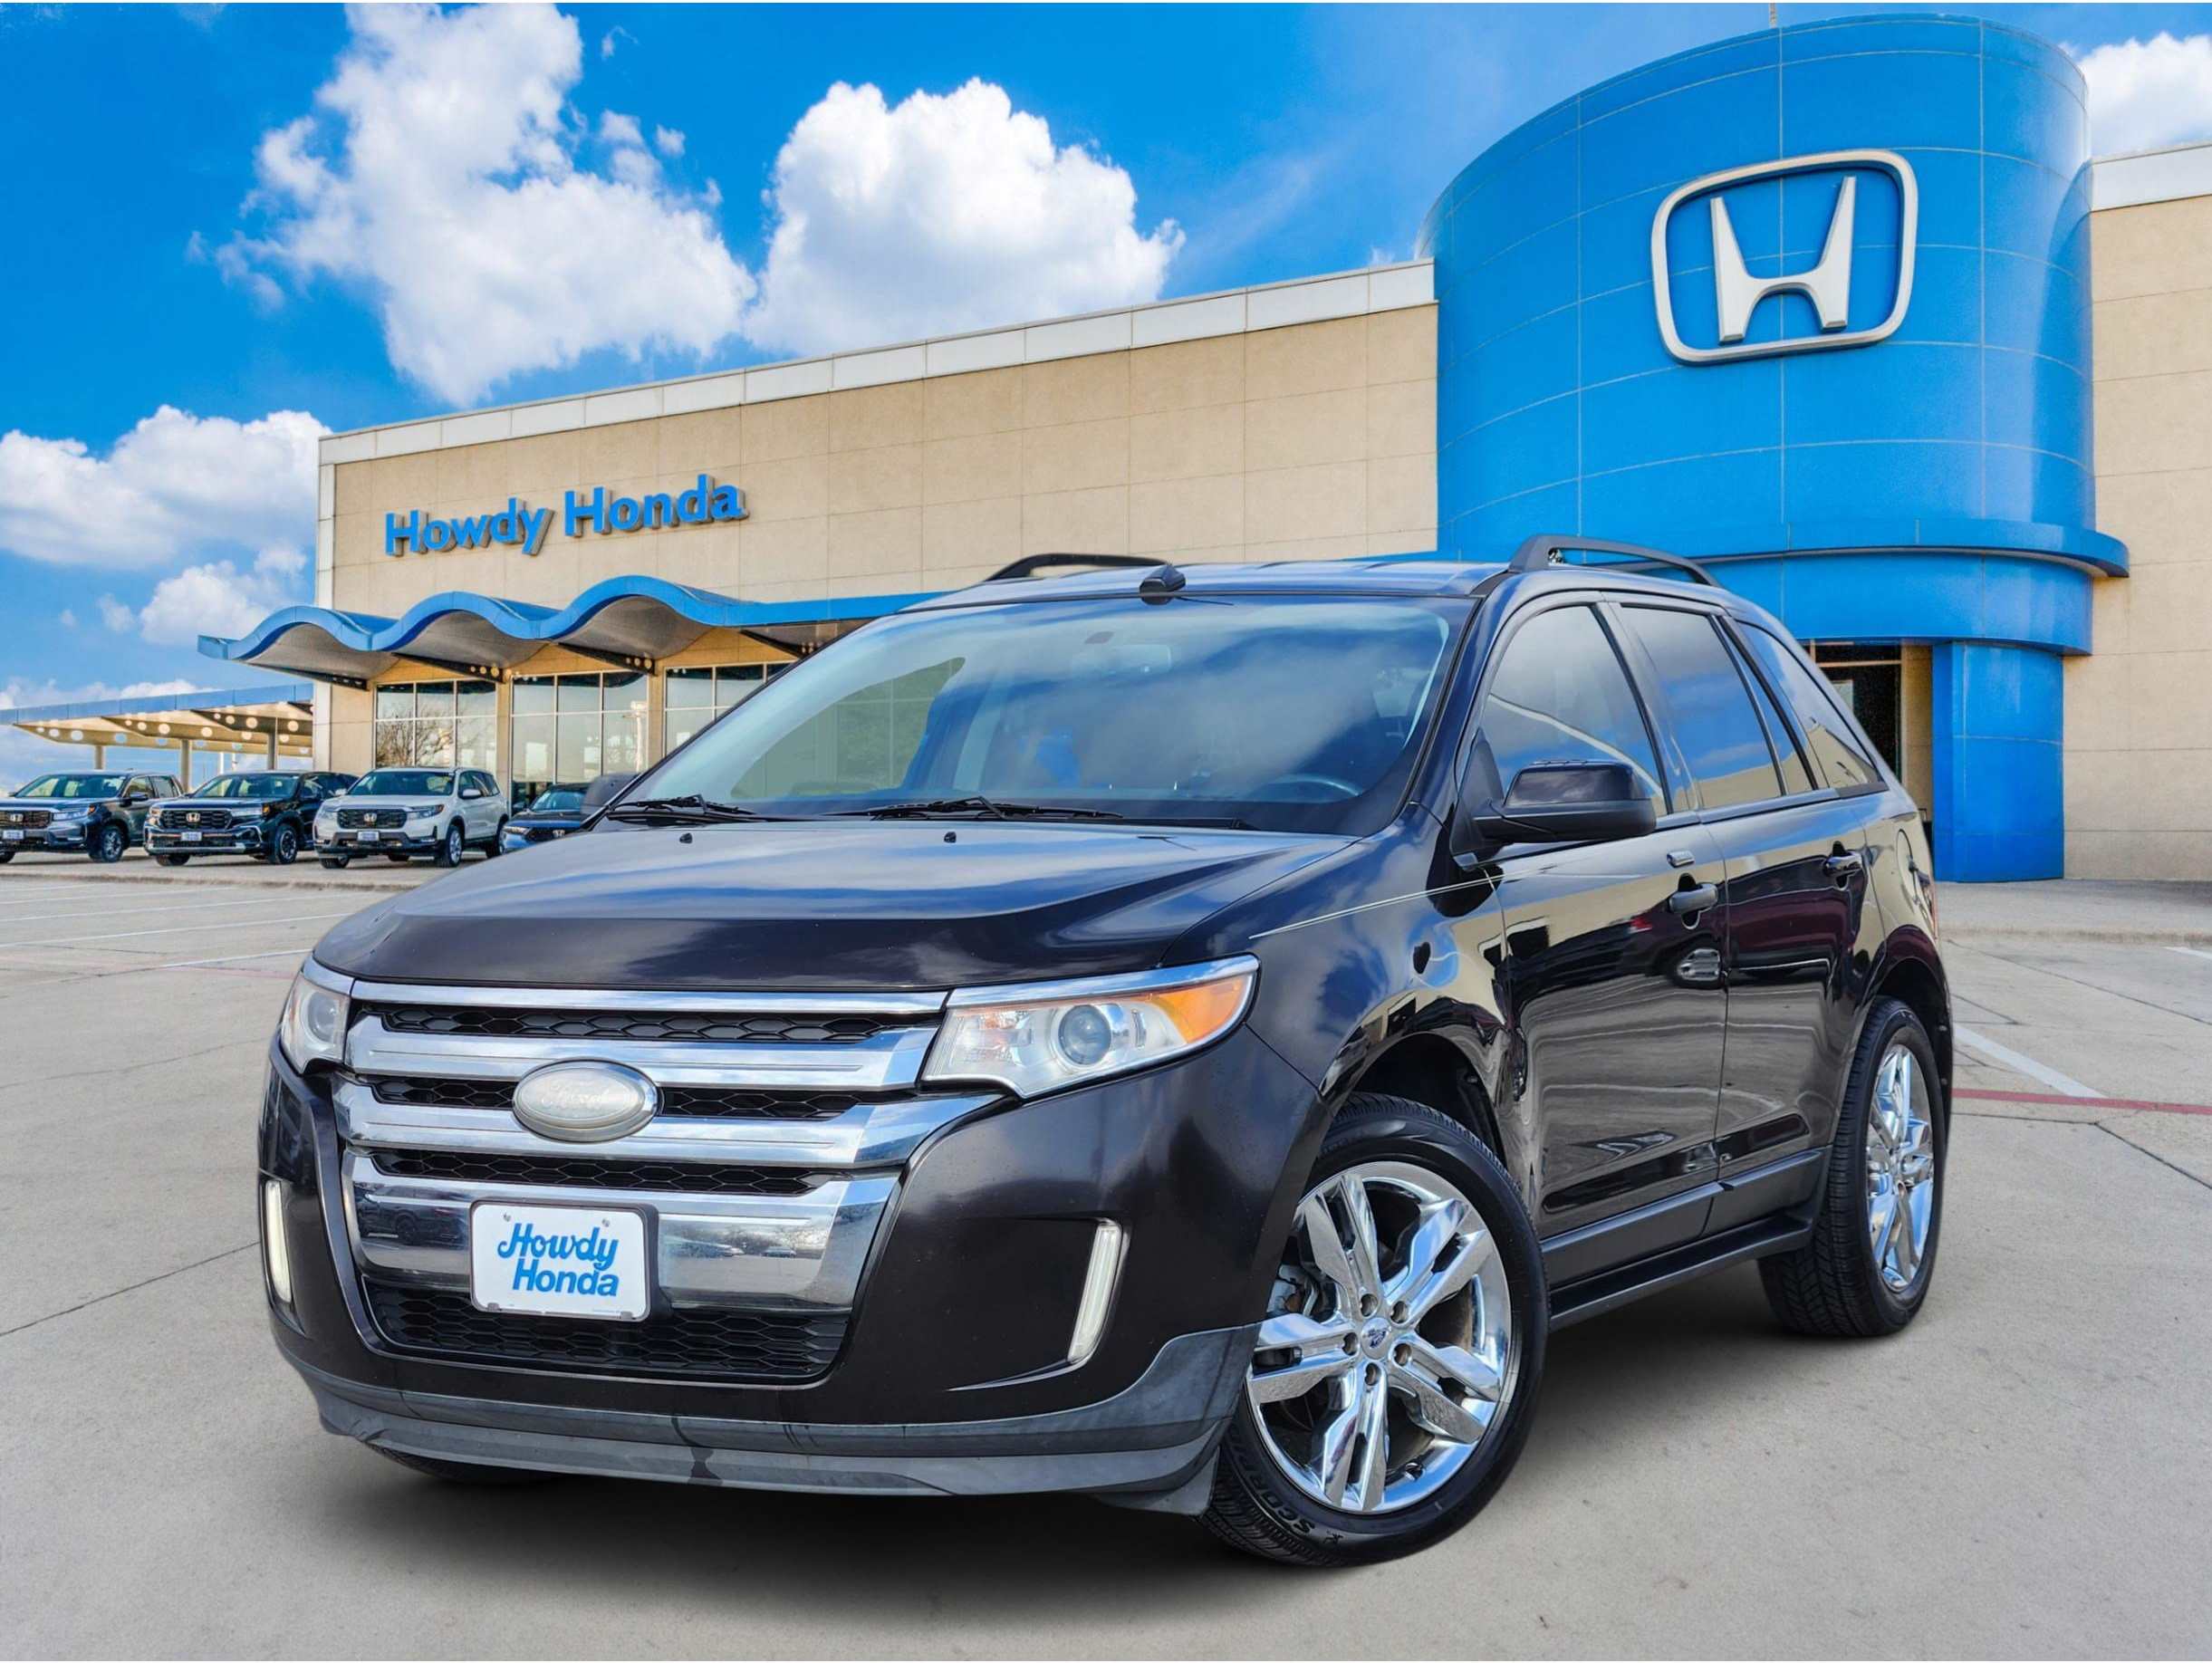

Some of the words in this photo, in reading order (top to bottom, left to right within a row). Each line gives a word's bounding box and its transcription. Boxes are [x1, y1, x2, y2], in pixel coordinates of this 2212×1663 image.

[385, 497, 554, 556] Howdy
[563, 474, 749, 537] Honda
[497, 1222, 619, 1271] Howdy
[513, 1258, 620, 1296] Honda
